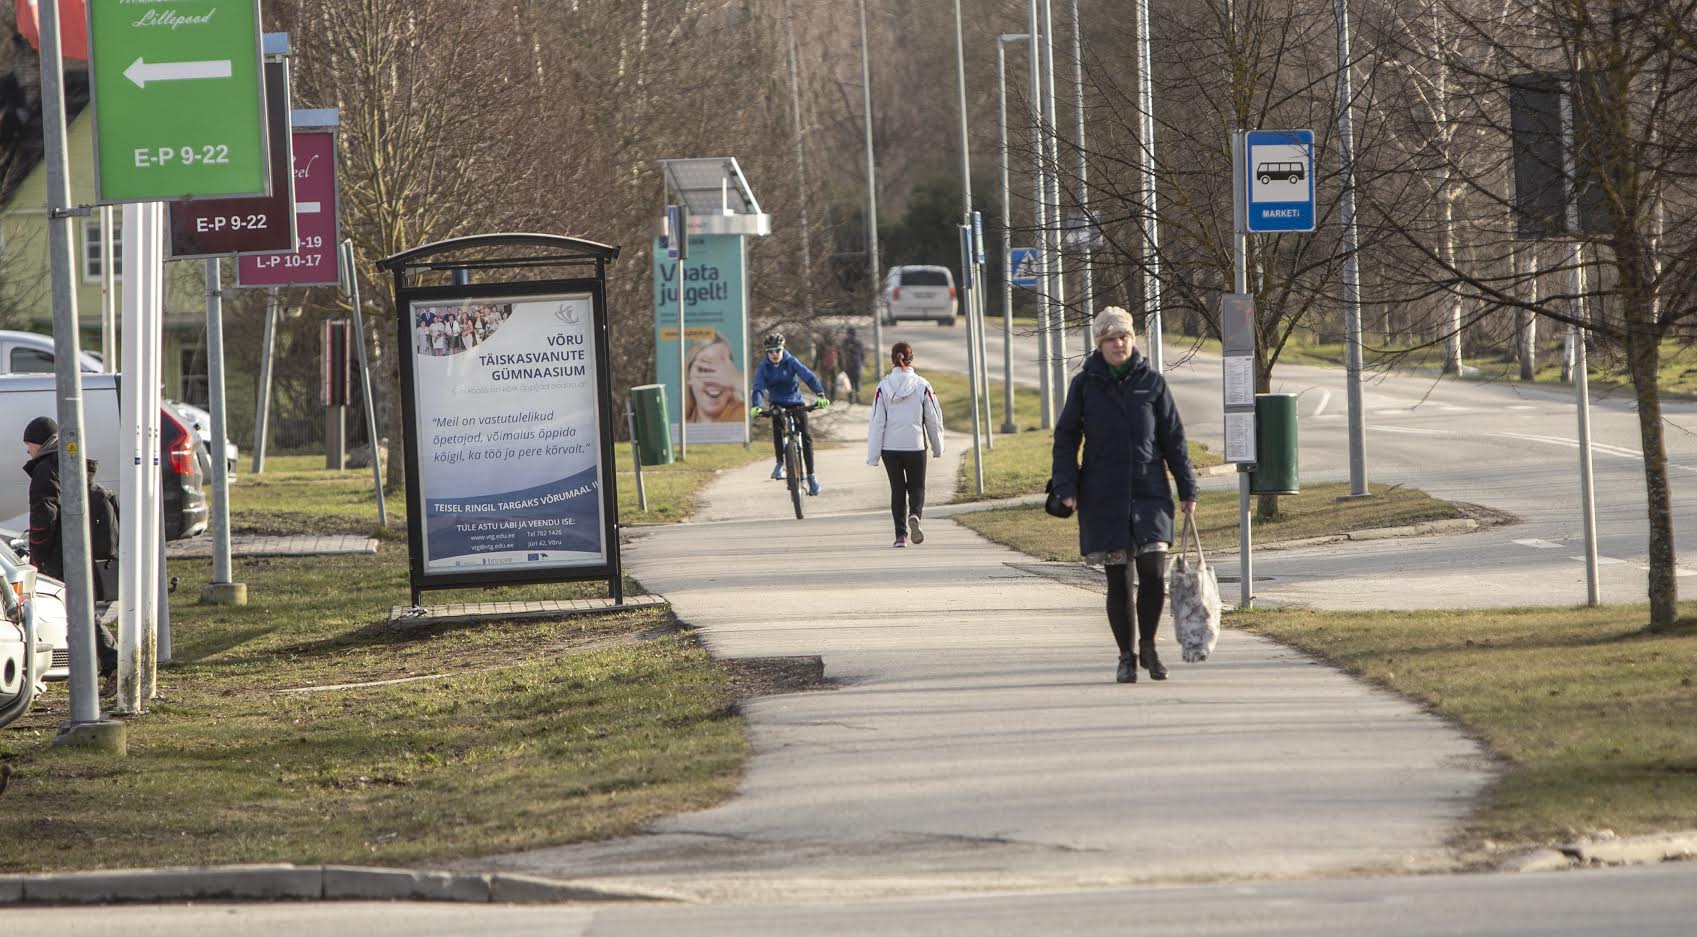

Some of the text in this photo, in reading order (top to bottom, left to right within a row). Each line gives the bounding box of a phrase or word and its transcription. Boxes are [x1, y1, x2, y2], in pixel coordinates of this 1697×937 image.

[131, 8, 216, 30] Lillepood
[134, 145, 230, 167] E-P 9-22
[196, 215, 267, 232] E-P 9-22
[256, 254, 322, 268] L-P 10-17
[658, 281, 728, 306] jugelt!
[547, 334, 584, 347] VÕRU
[479, 350, 585, 366] TÄISKASVANUTE
[492, 365, 586, 381] GÜMNAASIUM
[461, 418, 476, 427] on
[479, 411, 554, 425] vastutulelikud
[433, 427, 577, 447] õpetajad, võimalus õppida
[434, 451, 465, 464] kõigil,
[468, 450, 481, 461] ka
[484, 448, 502, 460] töö
[503, 449, 515, 461] ja
[517, 446, 542, 459] pere
[434, 503, 463, 513] TEISEL
[465, 502, 496, 513] RINGIL
[498, 498, 540, 511] TARGAKS
[540, 484, 592, 505] VÕRUMAAL
[457, 517, 576, 532] TULE ASTU LÄBI JA VEENDU ISE:
